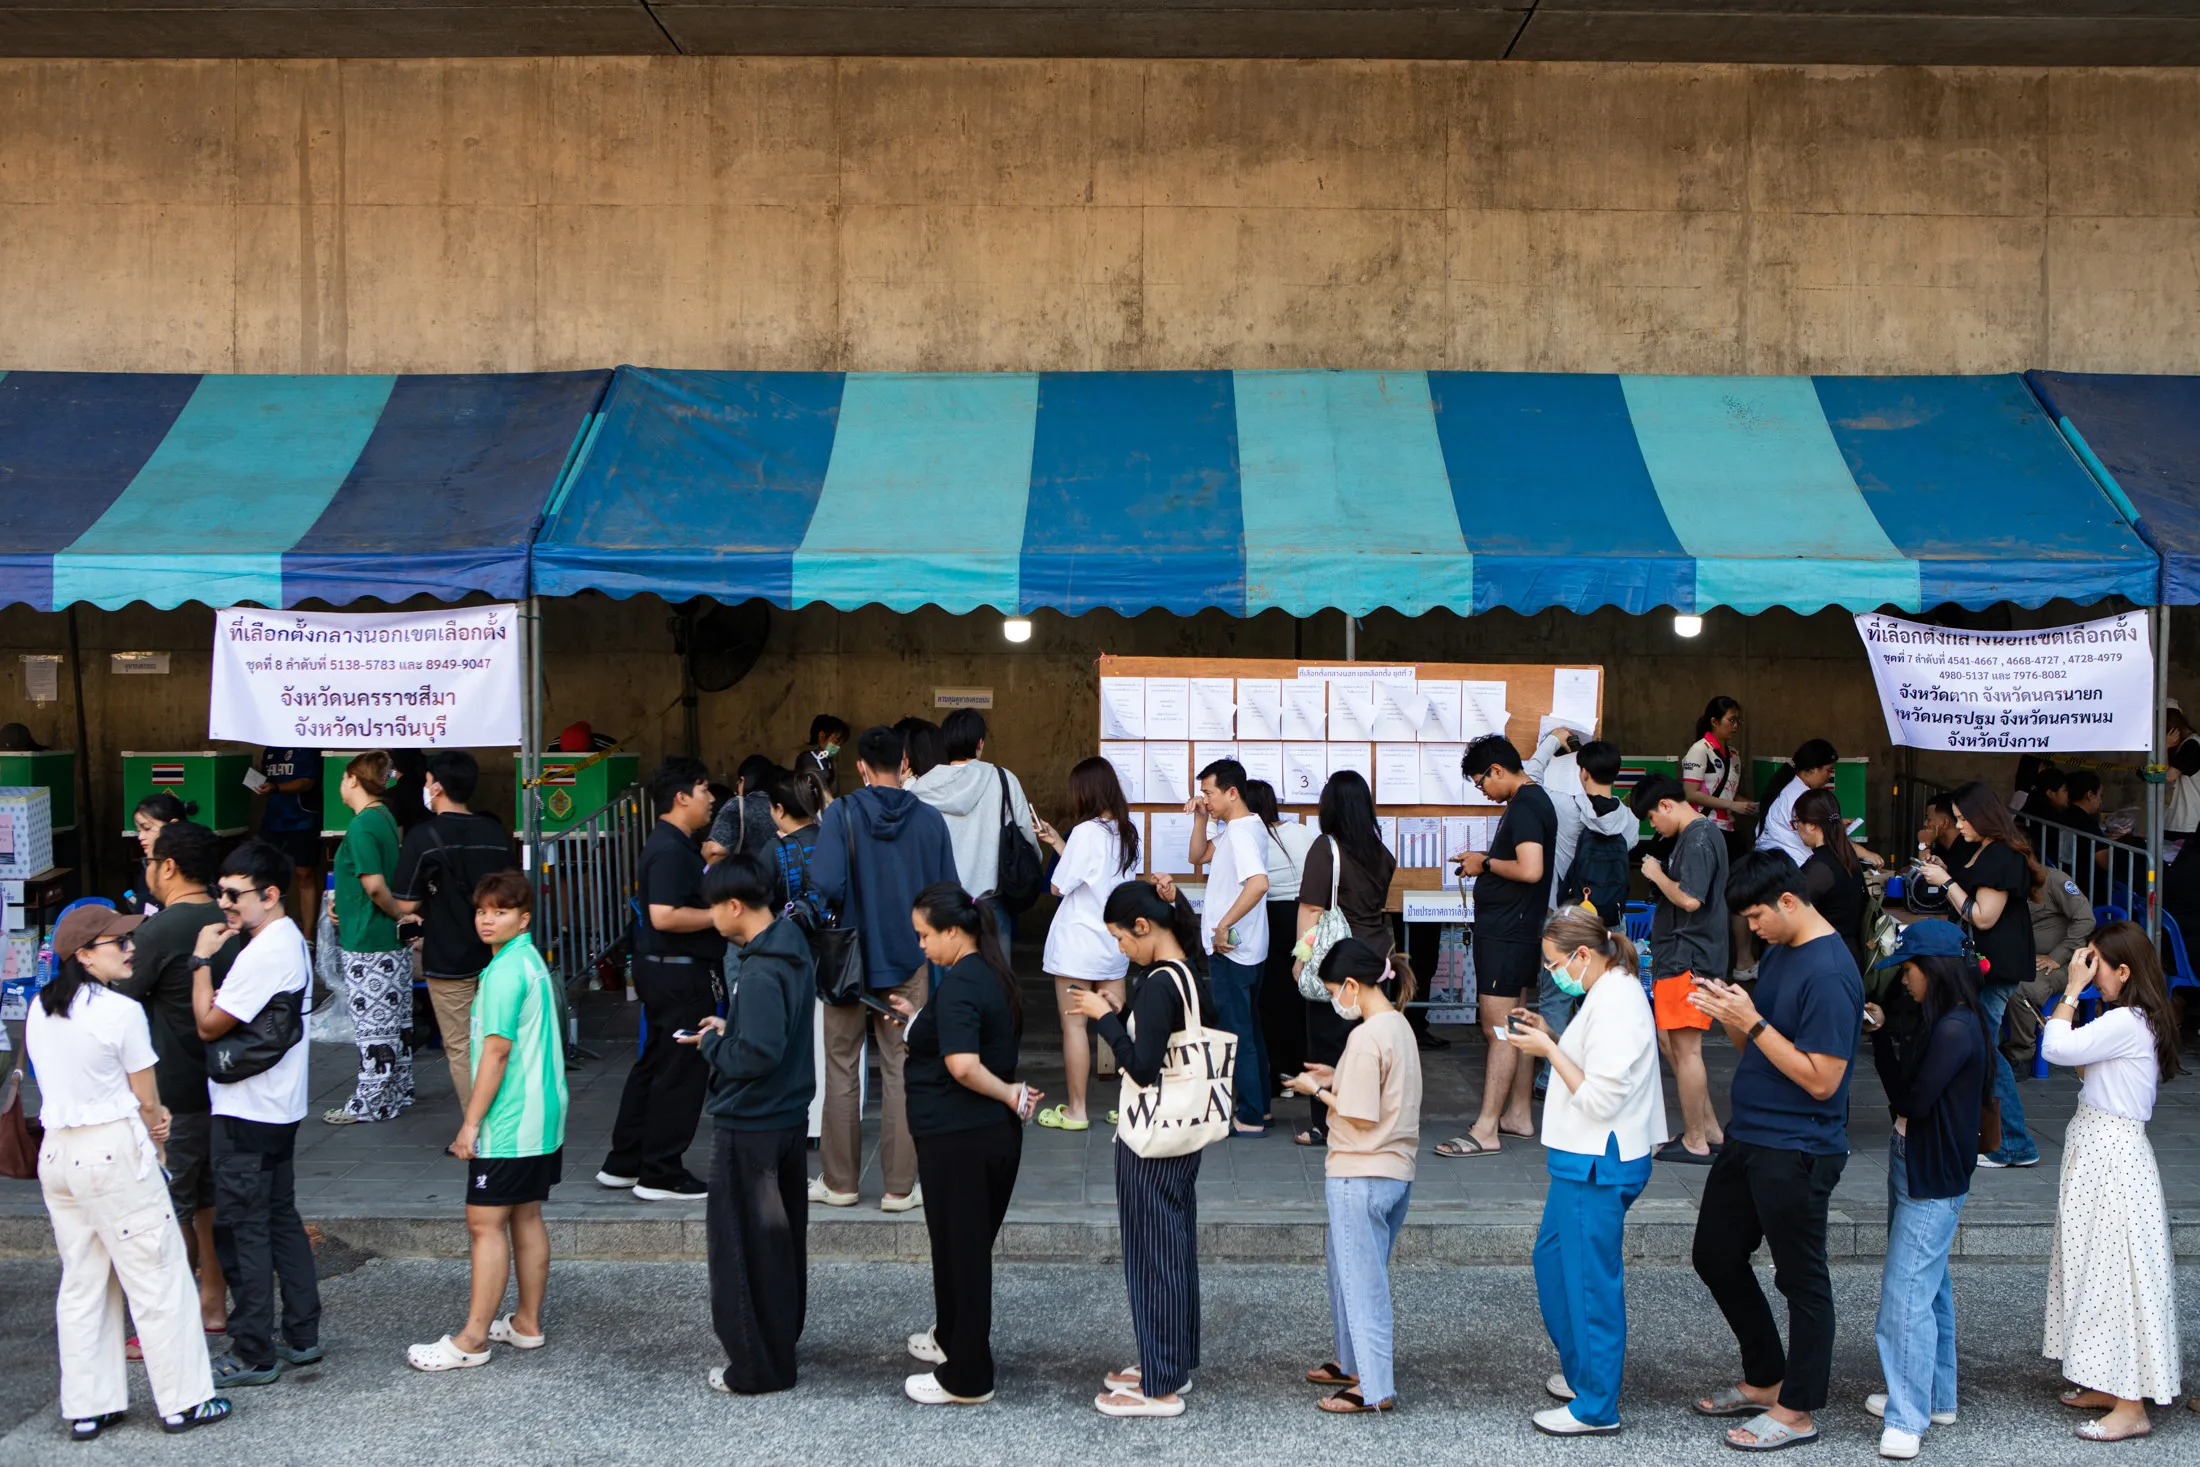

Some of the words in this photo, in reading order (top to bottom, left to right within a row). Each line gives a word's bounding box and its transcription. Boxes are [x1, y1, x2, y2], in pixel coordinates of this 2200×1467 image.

[229, 613, 506, 643] ที่เลือกตั้งกลางนอกเขตเลือกตั้ง
[246, 654, 272, 674] ชุดที่
[275, 659, 283, 671] 8
[286, 654, 327, 671] ลำดับที่
[330, 659, 396, 671] 5138-5783
[399, 659, 423, 671] และ
[426, 658, 491, 671] 8949-9047
[1883, 652, 1905, 665] ชุดที่
[1907, 654, 1913, 664] 7
[1915, 652, 1945, 665] ลำดับที่
[1947, 656, 1998, 665] 4541-4667
[2006, 655, 2059, 665] 4668-4727
[2068, 652, 2123, 664] 4728-4979
[1939, 671, 1989, 680] 4980-5137
[1992, 671, 2011, 680] และ
[2013, 670, 2067, 680] 7976-8082
[280, 684, 456, 707] จังหวัดนครราชสีมา
[1899, 683, 1978, 703] จังหวัดตาก
[1982, 684, 2103, 703] จังหวัดนครนายก
[2000, 708, 2113, 725] จังหวัดนครพนม
[295, 714, 447, 743] จังหวัดปราจีนบุรี
[1947, 732, 2049, 748] จังหวัดบึงกาฬ
[1300, 775, 1309, 788] 3
